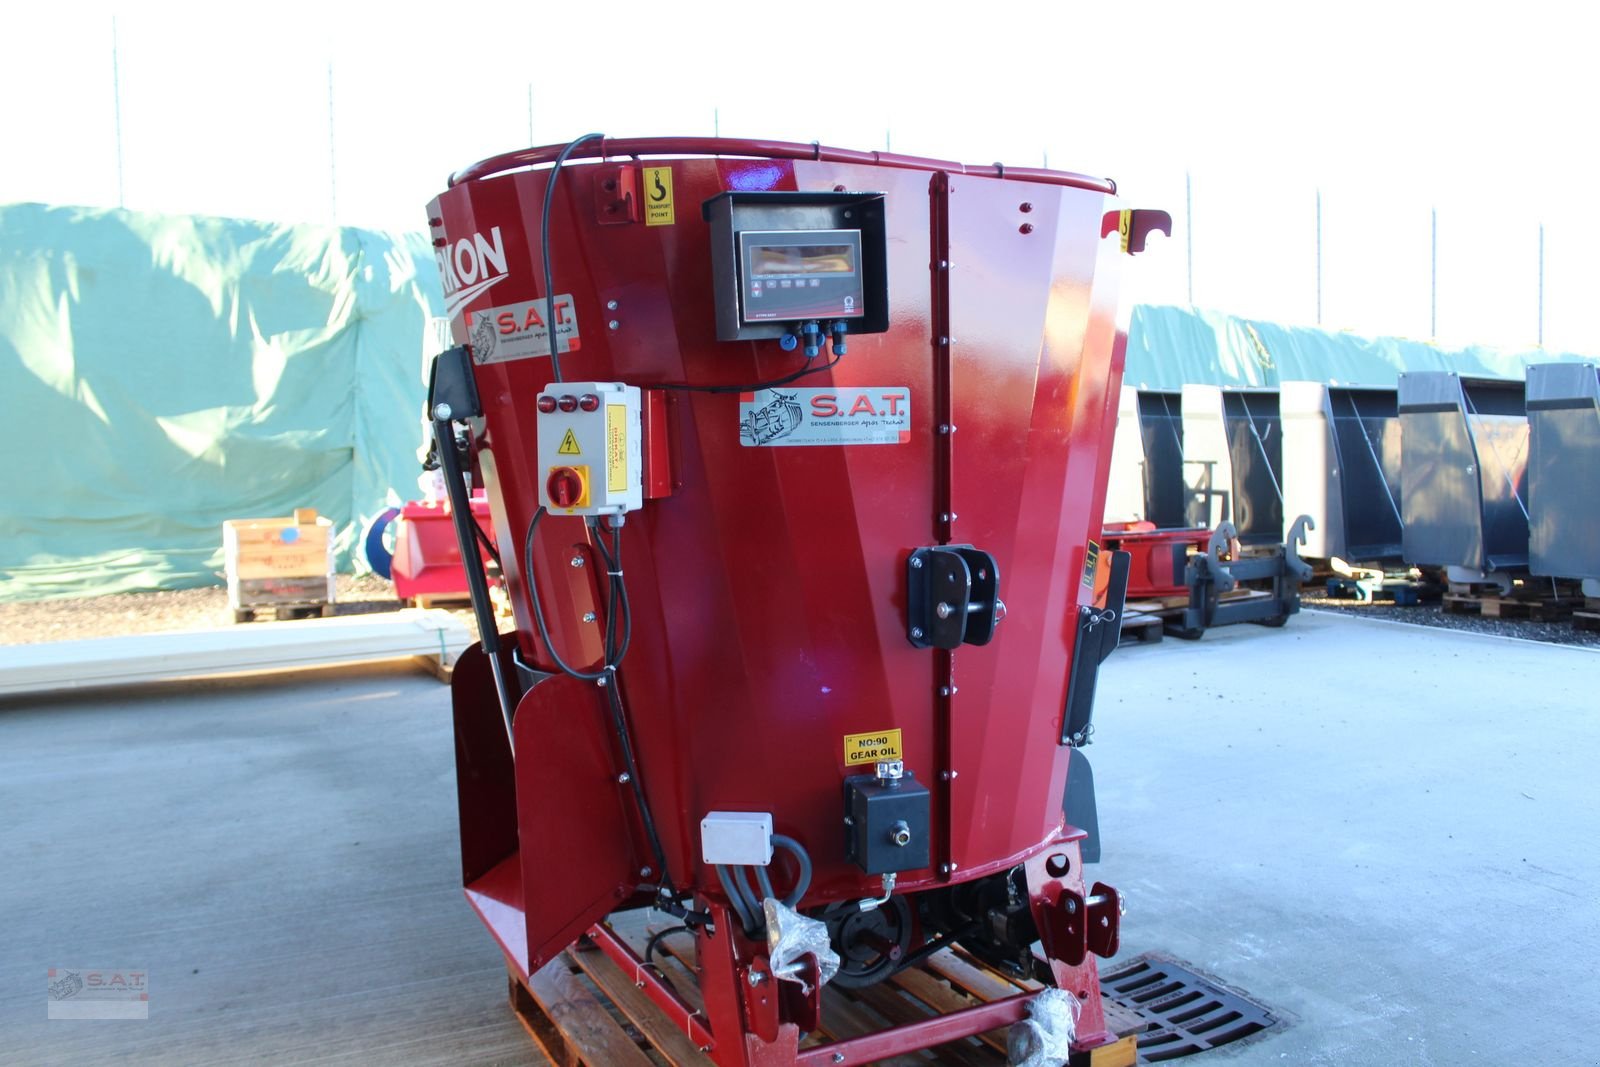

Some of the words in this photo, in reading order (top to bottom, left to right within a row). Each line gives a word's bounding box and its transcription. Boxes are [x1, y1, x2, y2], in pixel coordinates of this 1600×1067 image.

[810, 394, 905, 417] S.A.T.
[859, 737, 888, 747] NO:90
[850, 750, 877, 760] GEAR
[880, 748, 897, 756] OIL
